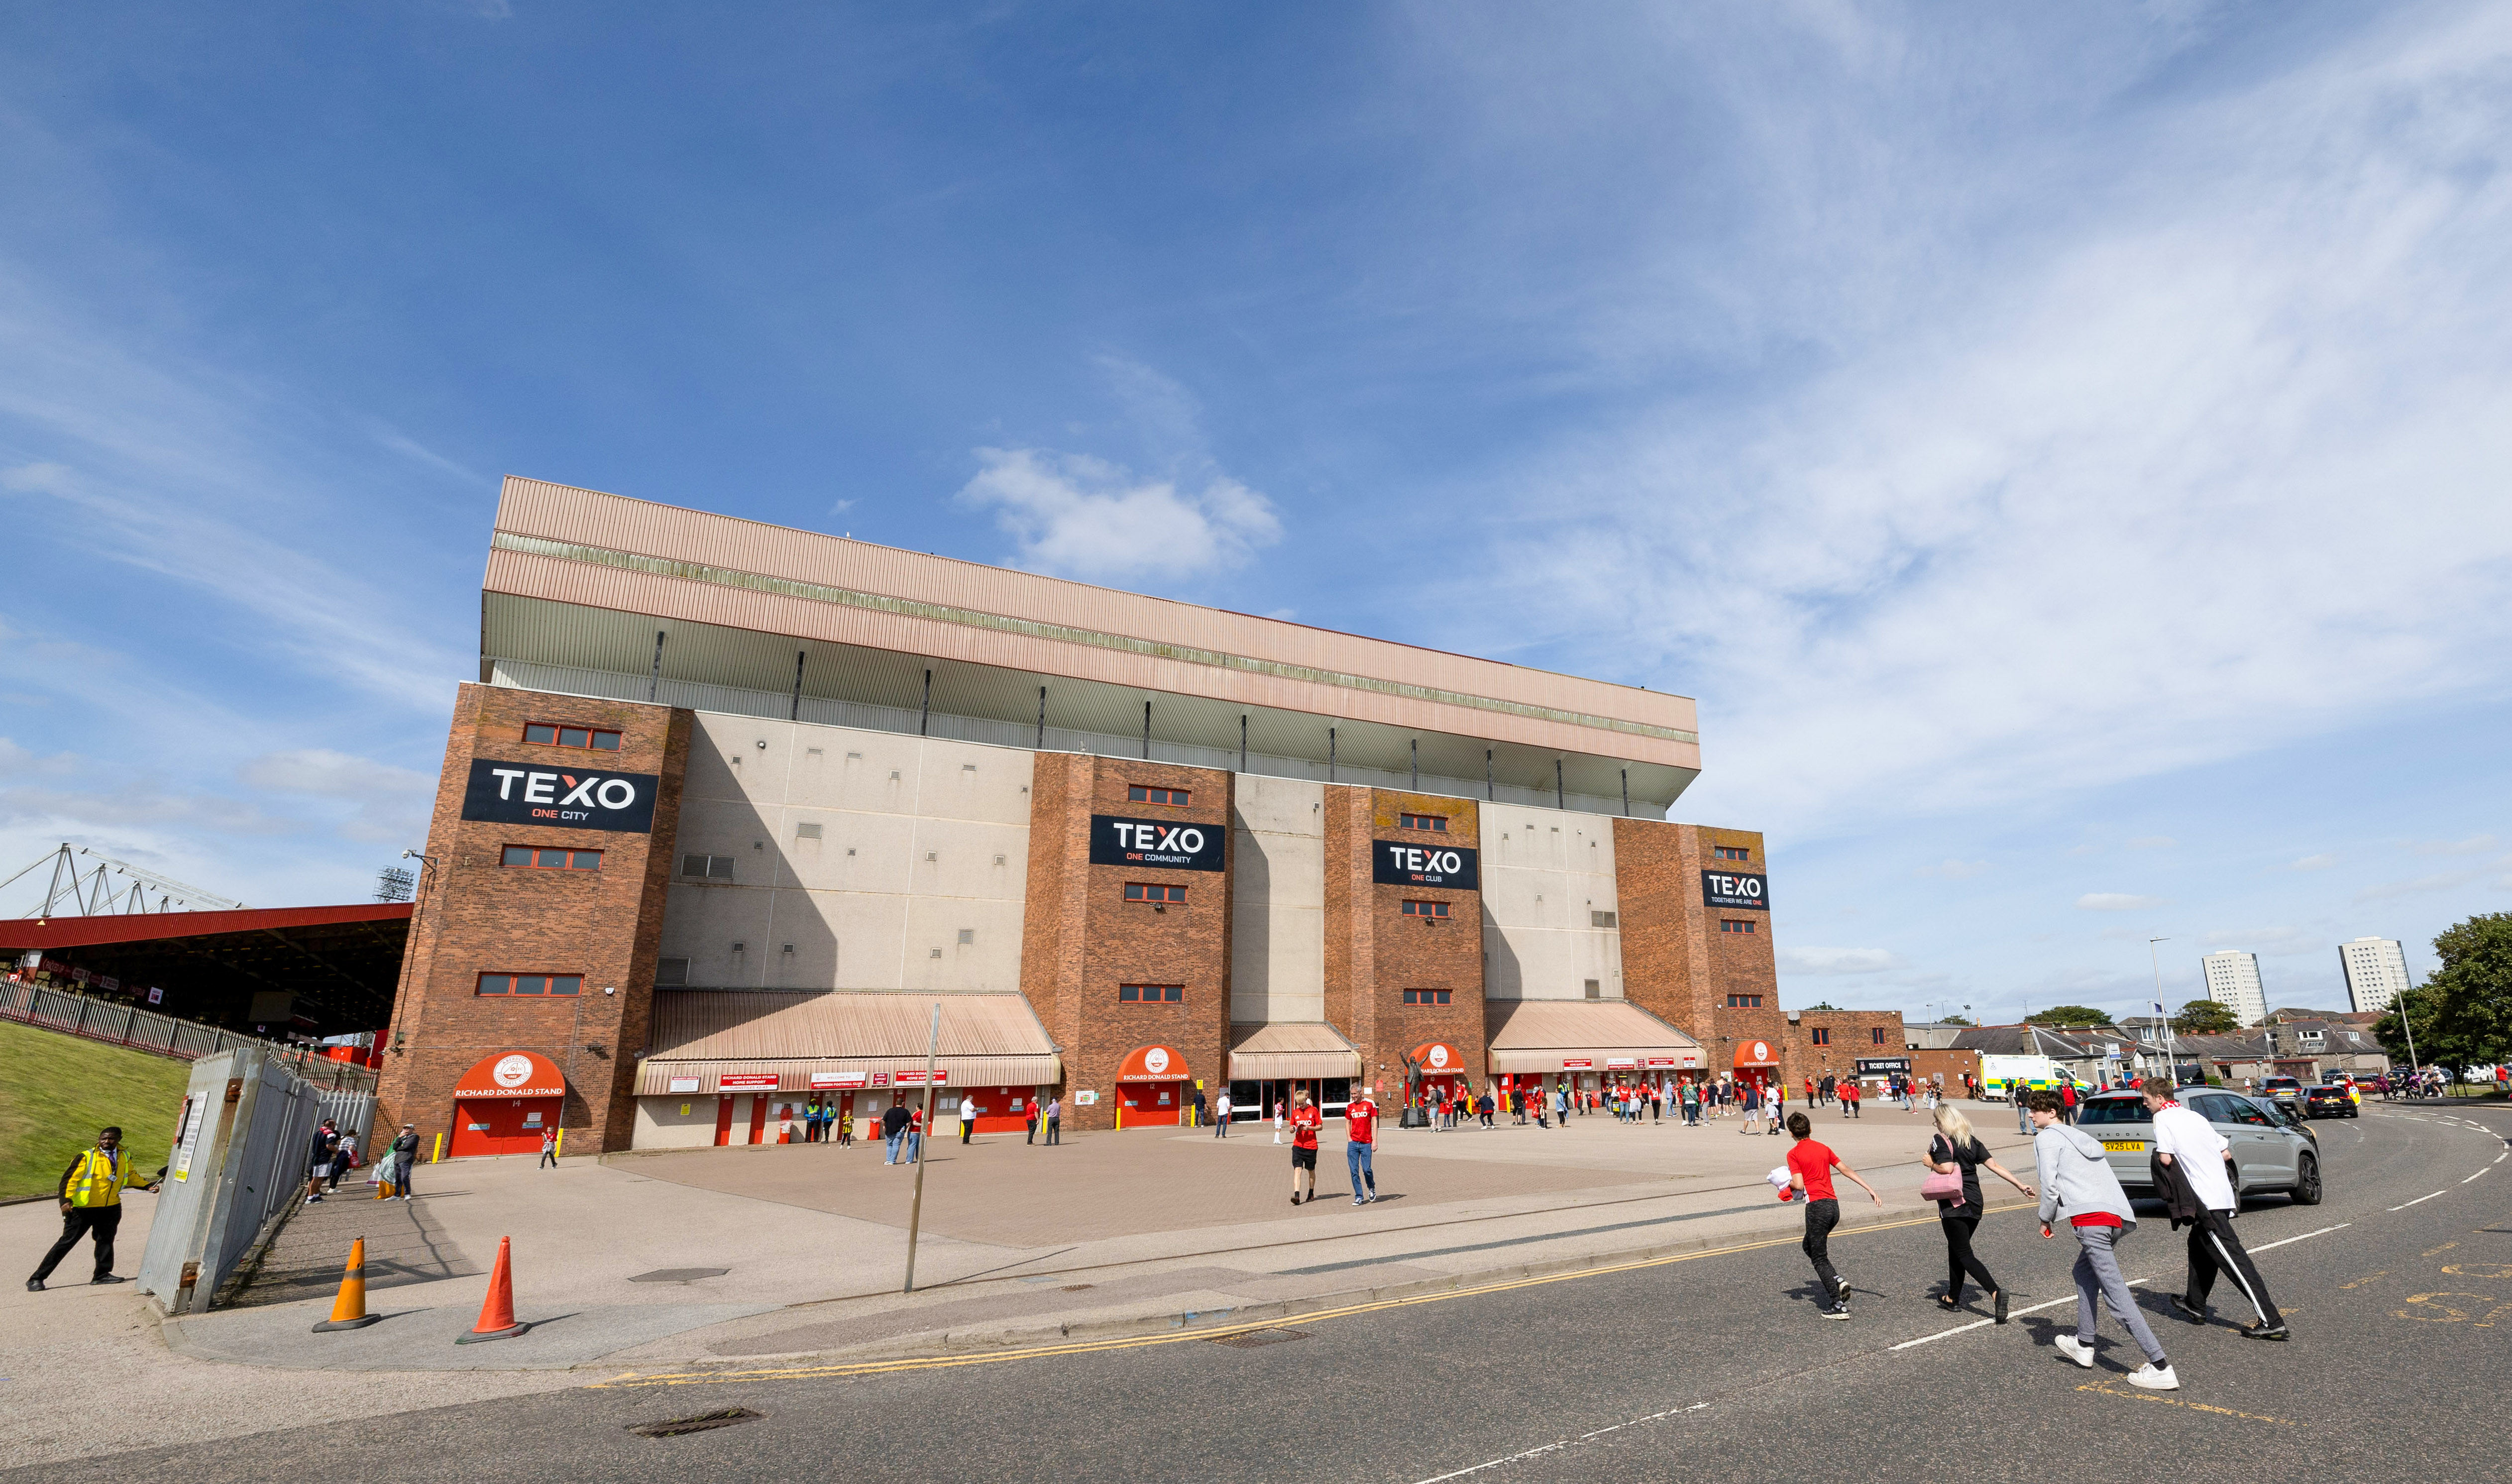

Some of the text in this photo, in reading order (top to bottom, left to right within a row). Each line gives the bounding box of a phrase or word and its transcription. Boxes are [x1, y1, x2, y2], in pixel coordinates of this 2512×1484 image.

[492, 768, 635, 810] TEXO
[532, 809, 589, 821] ONE CITY
[1113, 823, 1204, 853] TEXO
[1145, 853, 1191, 863] COMMUNITY
[1390, 847, 1461, 874] TEXO
[1709, 875, 1760, 897] TEXO
[496, 1072, 517, 1085] FOOTBALL
